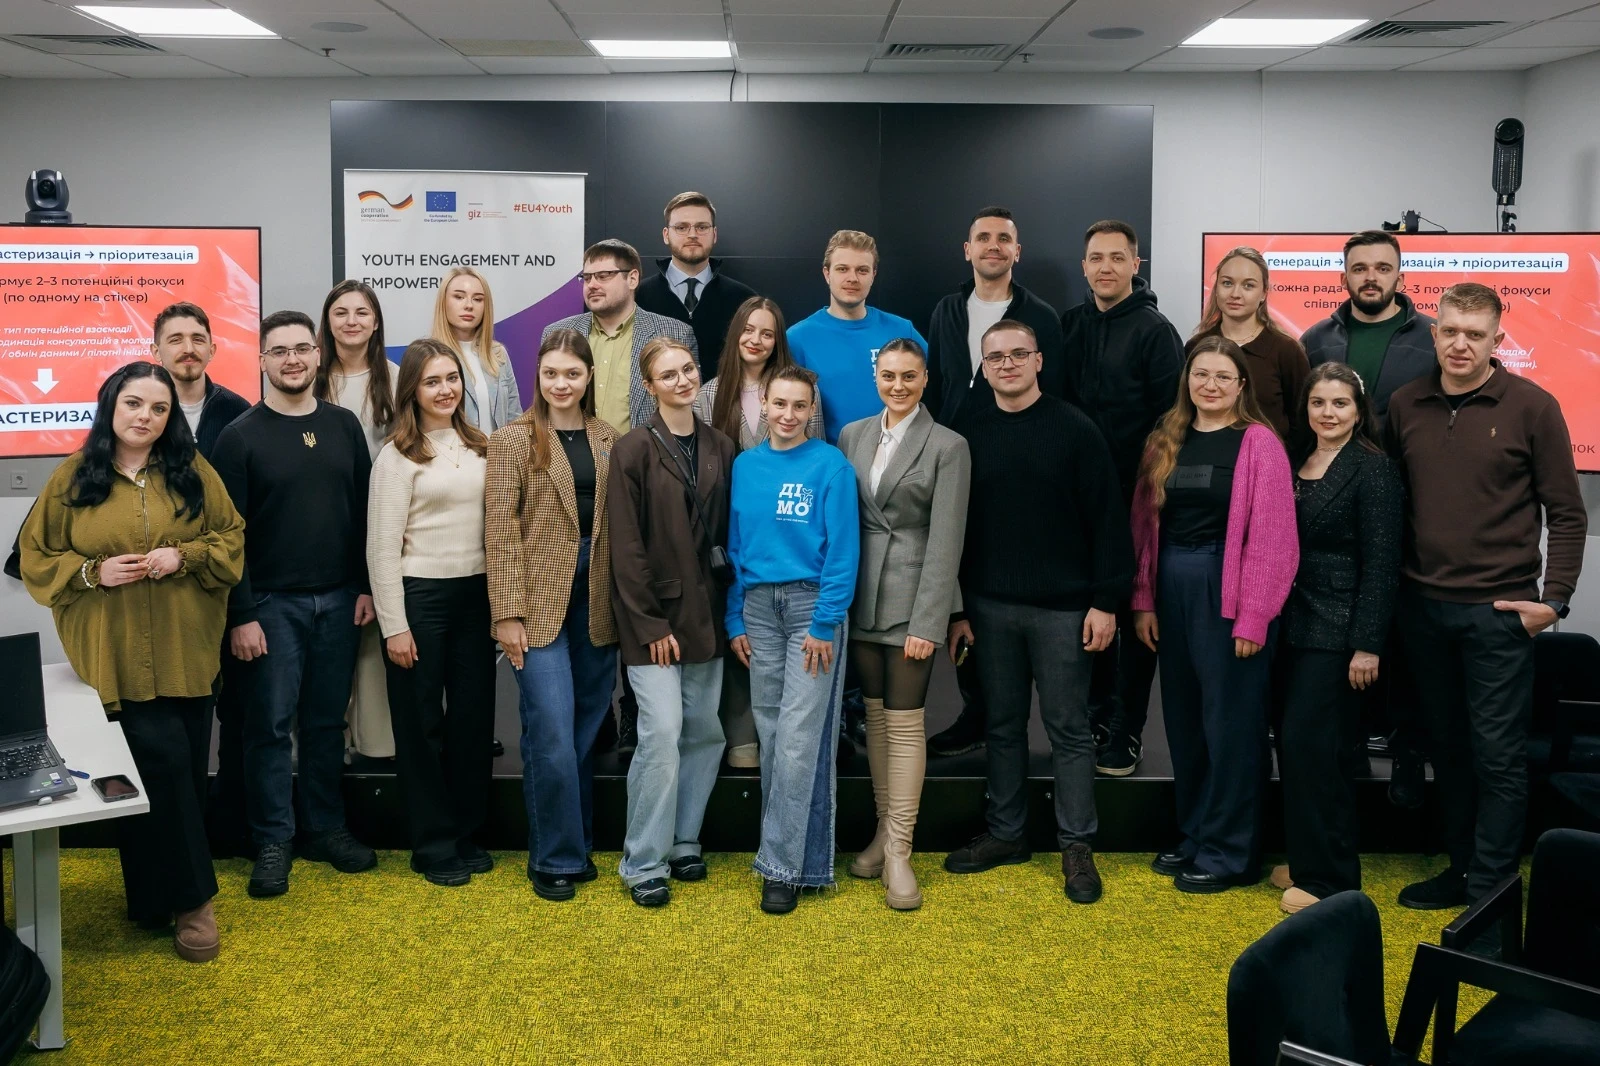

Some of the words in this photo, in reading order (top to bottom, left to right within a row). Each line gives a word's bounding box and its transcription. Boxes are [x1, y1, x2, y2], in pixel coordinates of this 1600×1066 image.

[513, 203, 573, 213] #EU4Youth
[468, 209, 482, 220] giz
[99, 249, 194, 262] пріоритезація
[361, 254, 414, 266] YOUTH
[419, 254, 520, 266] ENGAGEMENT
[524, 254, 556, 267] AND
[1267, 256, 1331, 268] генерація
[1462, 257, 1563, 270] пріоритезація
[36, 276, 58, 286] 2–3
[61, 275, 133, 287] потенційні
[137, 276, 184, 288] фокуси
[363, 277, 443, 289] EMPOWER
[1313, 285, 1343, 295] рада
[1500, 285, 1551, 297] фокуси
[3, 292, 25, 305] (по
[28, 294, 80, 304] одному
[84, 294, 100, 302] на
[103, 292, 148, 304] стікер)
[24, 325, 84, 335] потенційної
[85, 325, 132, 334] взаємодії
[46, 337, 111, 347] консультацій
[8, 349, 38, 358] обмін
[39, 350, 80, 359] даними
[87, 348, 121, 357] пілотні
[123, 347, 151, 357] ініціа
[1500, 360, 1538, 370] ативи).
